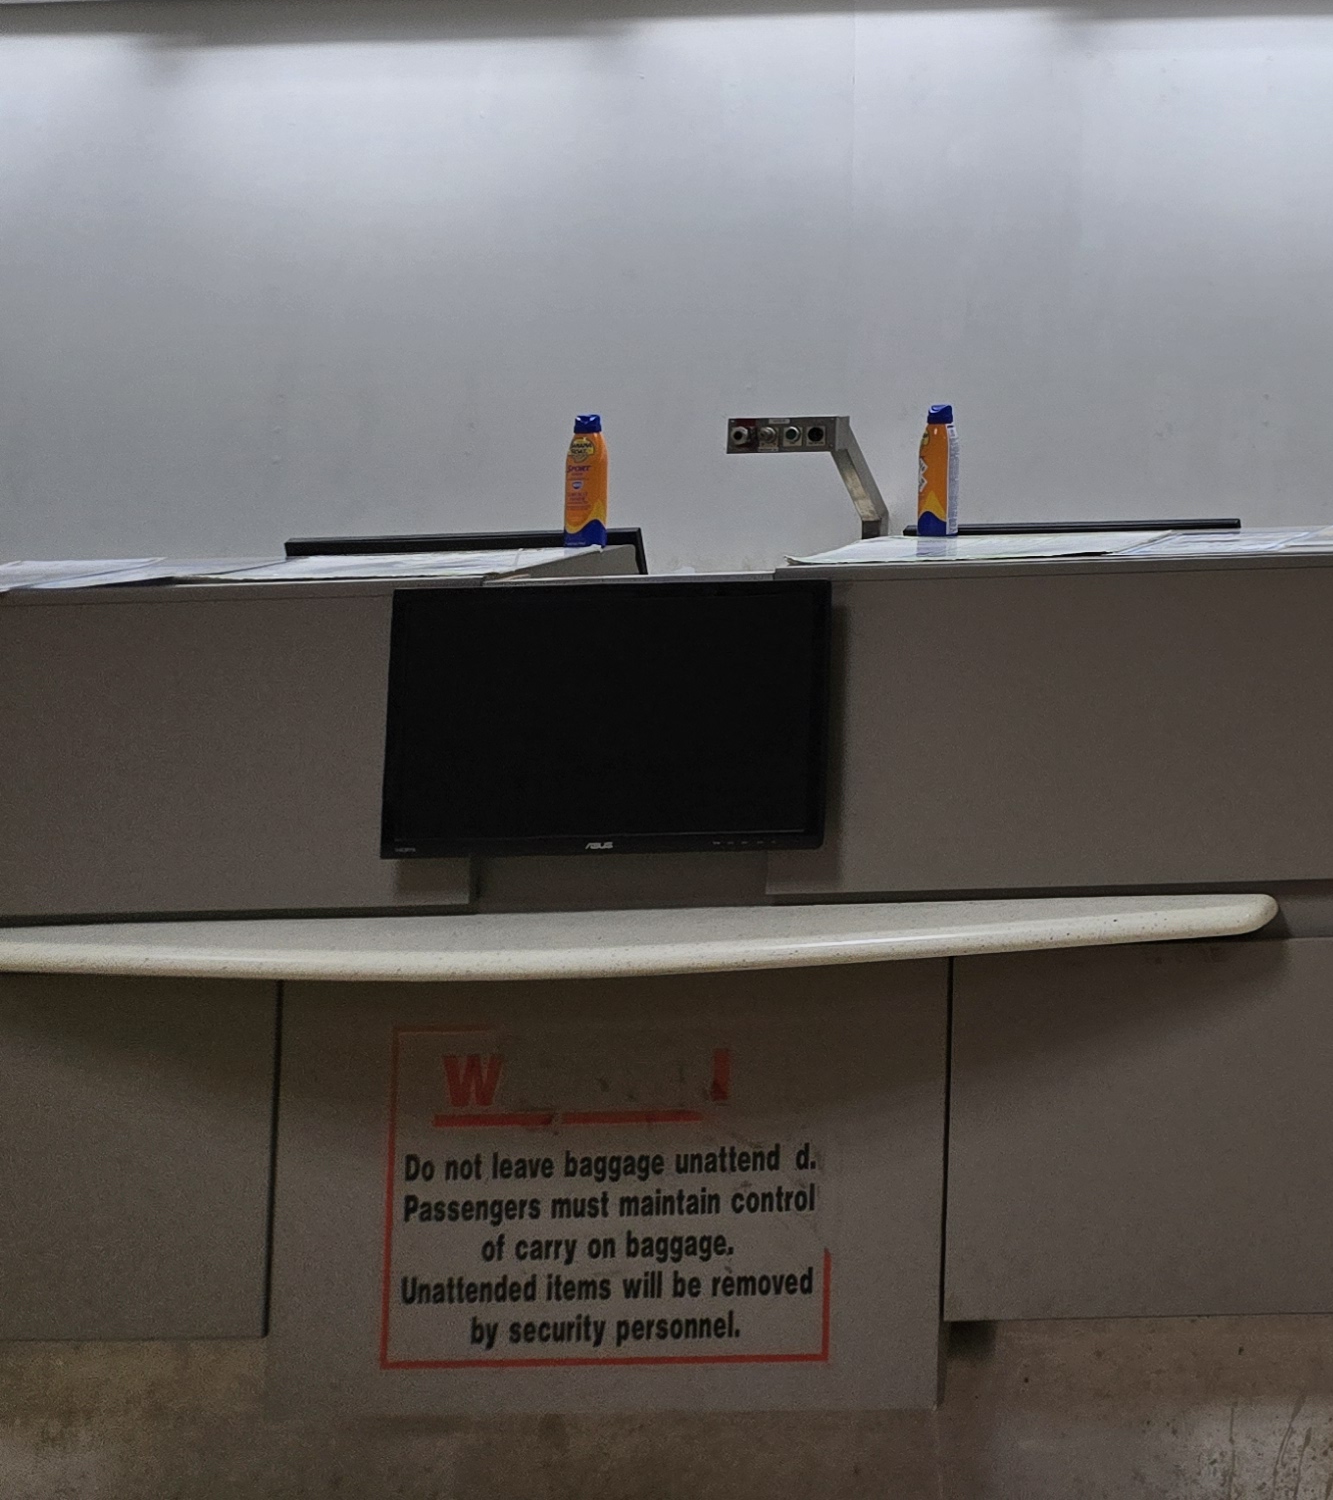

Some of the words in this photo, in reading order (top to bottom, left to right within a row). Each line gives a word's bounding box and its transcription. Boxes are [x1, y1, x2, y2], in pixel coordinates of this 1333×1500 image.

[585, 841, 613, 850] ASUS
[403, 1154, 435, 1182] Do
[445, 1152, 481, 1180] not
[492, 1151, 553, 1179] leave
[564, 1149, 665, 1183] baggage
[675, 1142, 816, 1173] unattendd.
[403, 1193, 541, 1226] Passengers
[551, 1191, 609, 1219] must
[619, 1188, 720, 1216] maintain
[731, 1183, 816, 1213] control
[481, 1235, 504, 1262] of
[515, 1234, 577, 1264] carry
[588, 1234, 616, 1258] on
[625, 1229, 734, 1264] baggage.
[401, 1273, 536, 1304] Unattended
[546, 1271, 611, 1301] items
[623, 1270, 663, 1299] will
[672, 1270, 701, 1297] be
[711, 1267, 814, 1297] removed
[470, 1315, 498, 1350] by
[509, 1313, 606, 1347] security
[616, 1310, 740, 1347] personnel.
